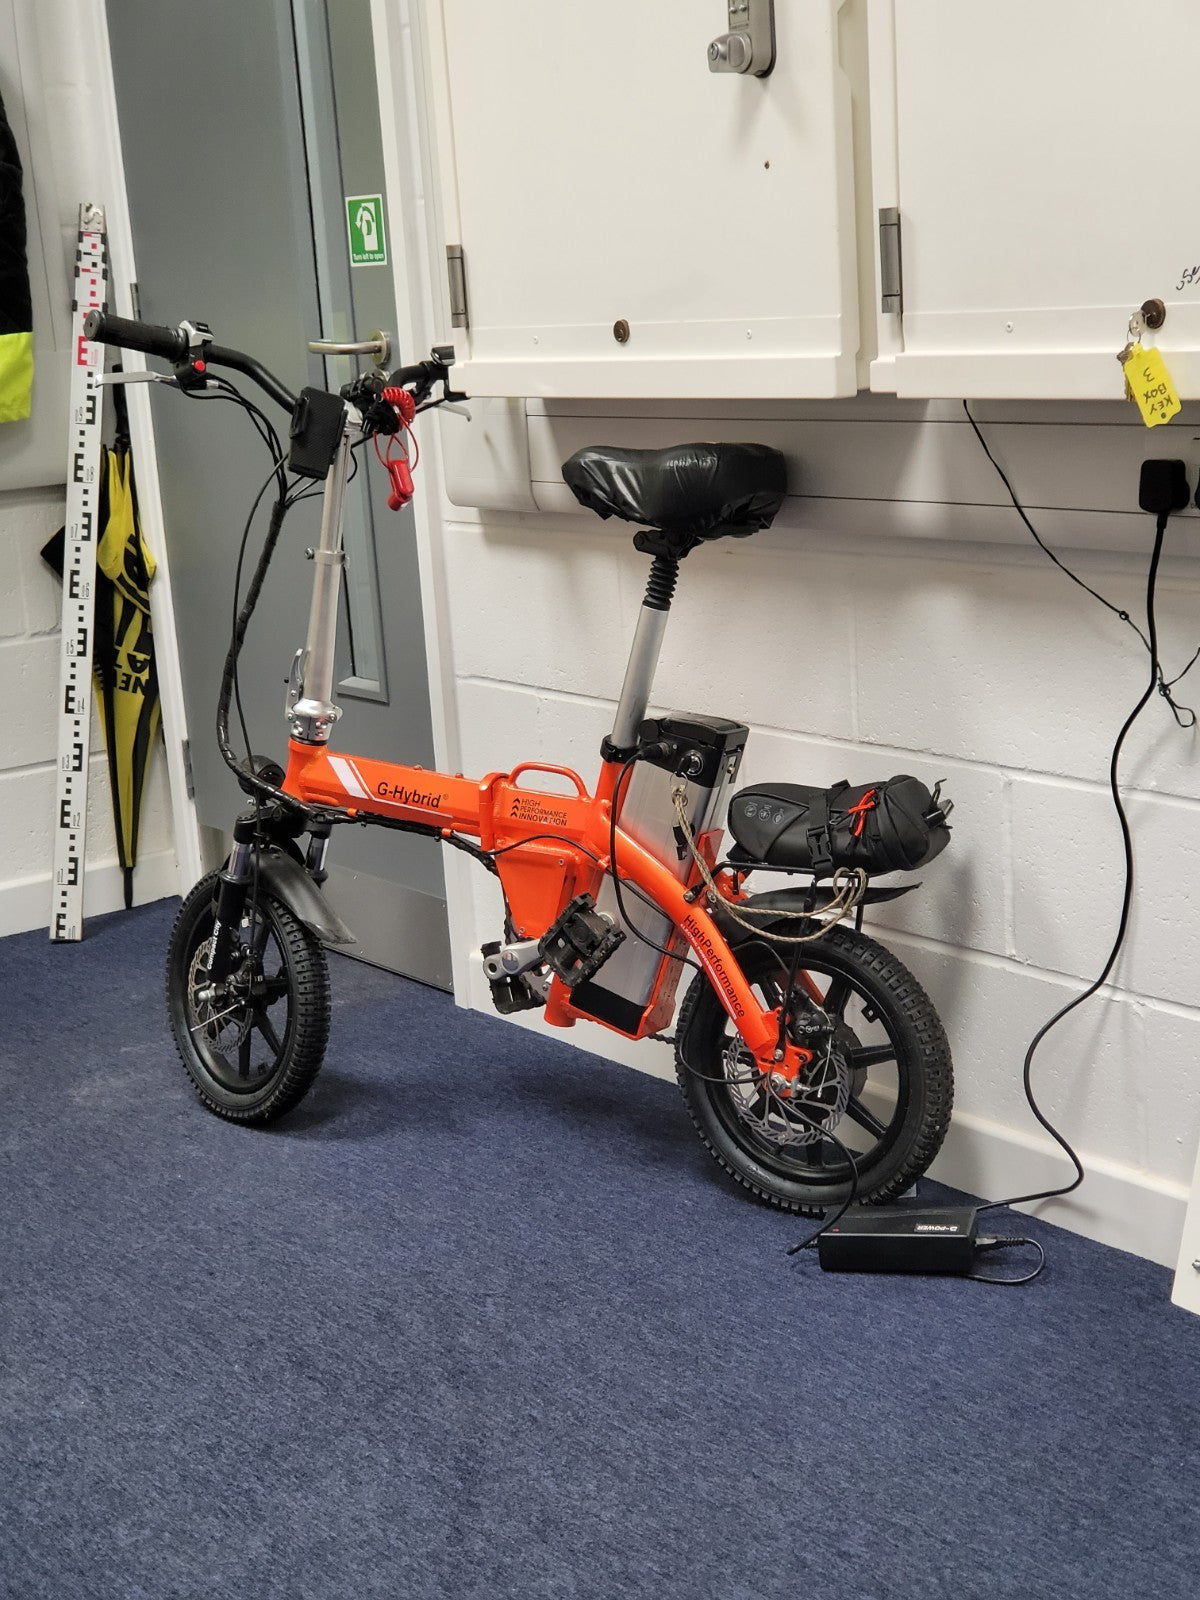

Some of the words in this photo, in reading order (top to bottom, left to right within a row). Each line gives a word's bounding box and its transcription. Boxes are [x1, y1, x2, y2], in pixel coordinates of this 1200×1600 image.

[1142, 367, 1155, 383] 3
[1143, 383, 1167, 403] BOX
[1149, 395, 1173, 415] KEY
[377, 781, 441, 809] G-Hybrid
[521, 798, 541, 807] HIGH
[519, 812, 567, 826] INNOVATION
[520, 805, 567, 819] PERFORMANCE
[207, 936, 217, 970] Compact
[213, 919, 222, 936] City
[683, 915, 745, 1018] HighPerformance
